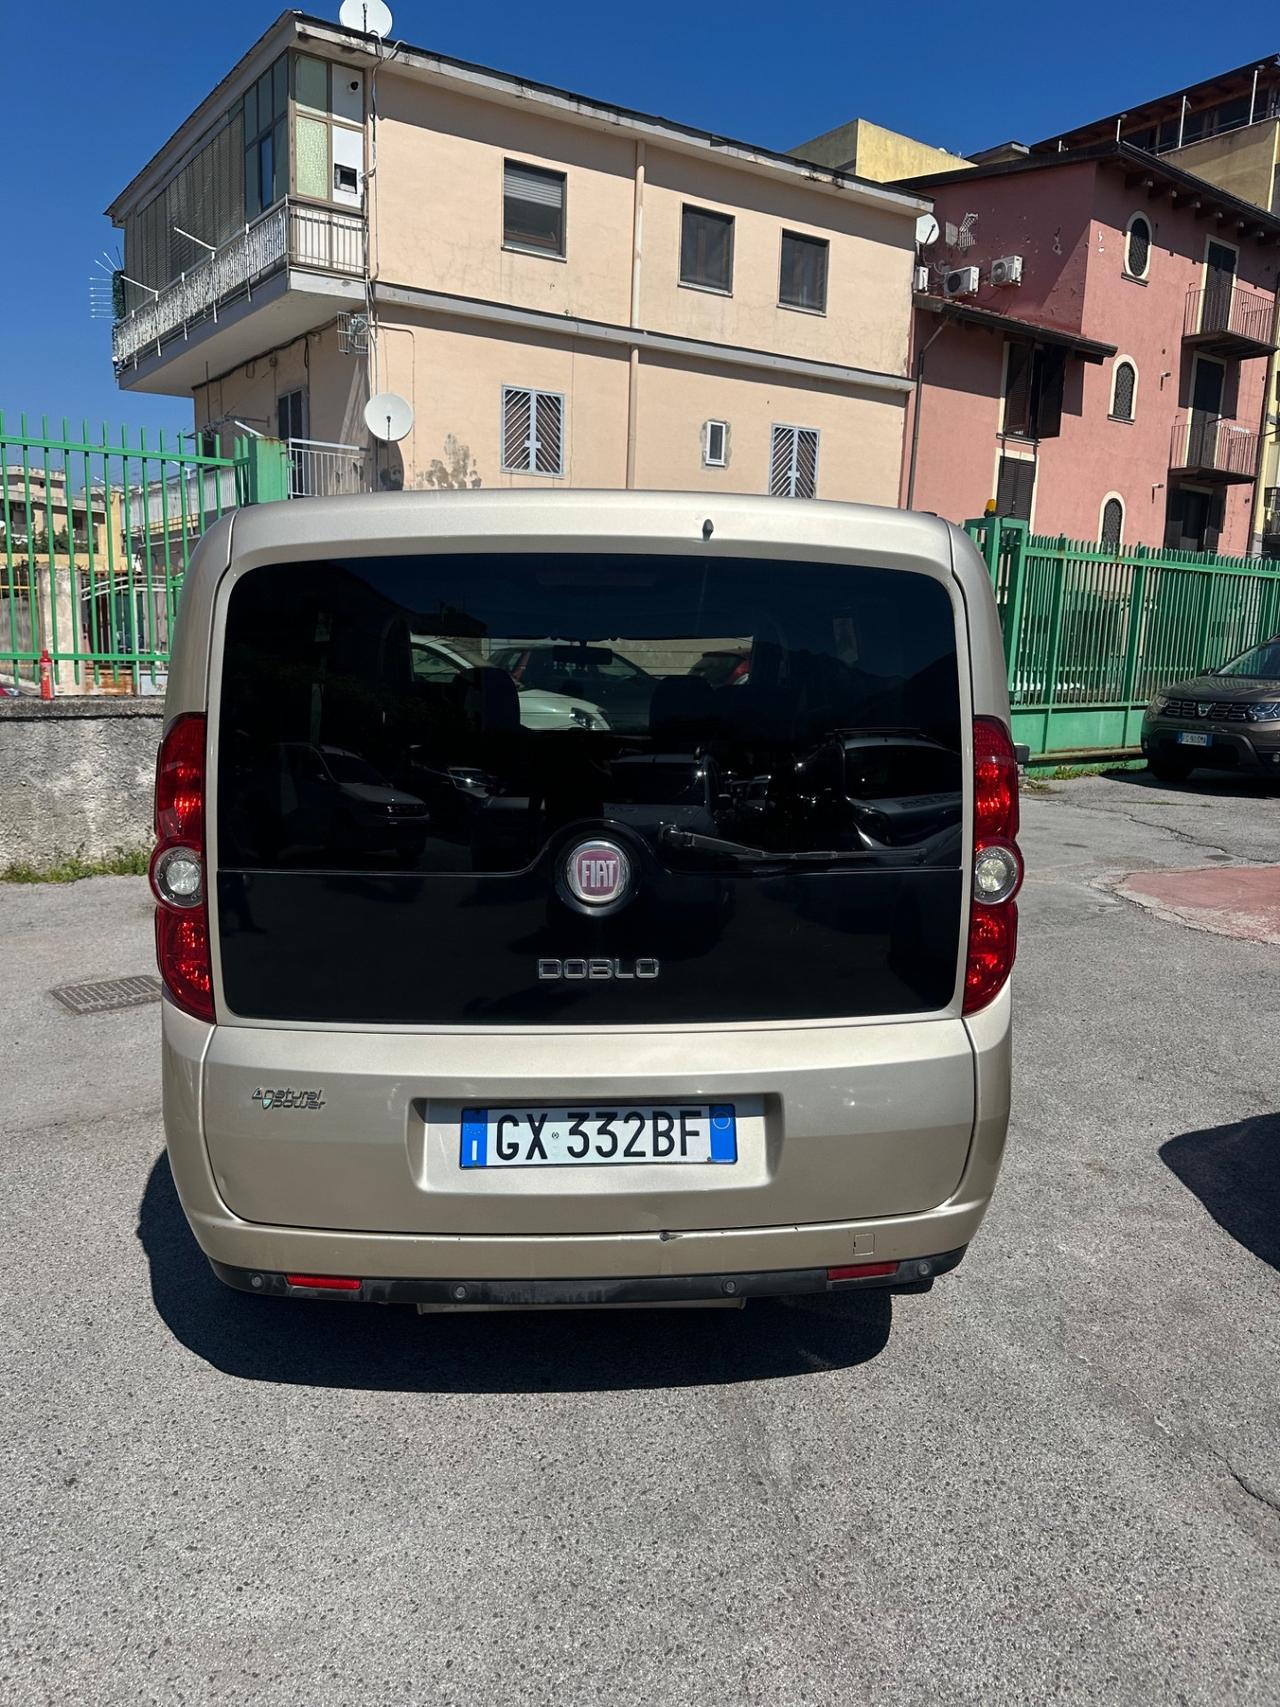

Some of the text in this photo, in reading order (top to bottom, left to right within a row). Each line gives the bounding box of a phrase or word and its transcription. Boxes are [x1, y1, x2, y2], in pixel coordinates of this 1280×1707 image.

[581, 860, 617, 888] FIAT
[538, 958, 660, 979] DOBLO
[264, 1087, 322, 1100] natural
[271, 1099, 326, 1110] power
[496, 1110, 703, 1161] GX 332BF
